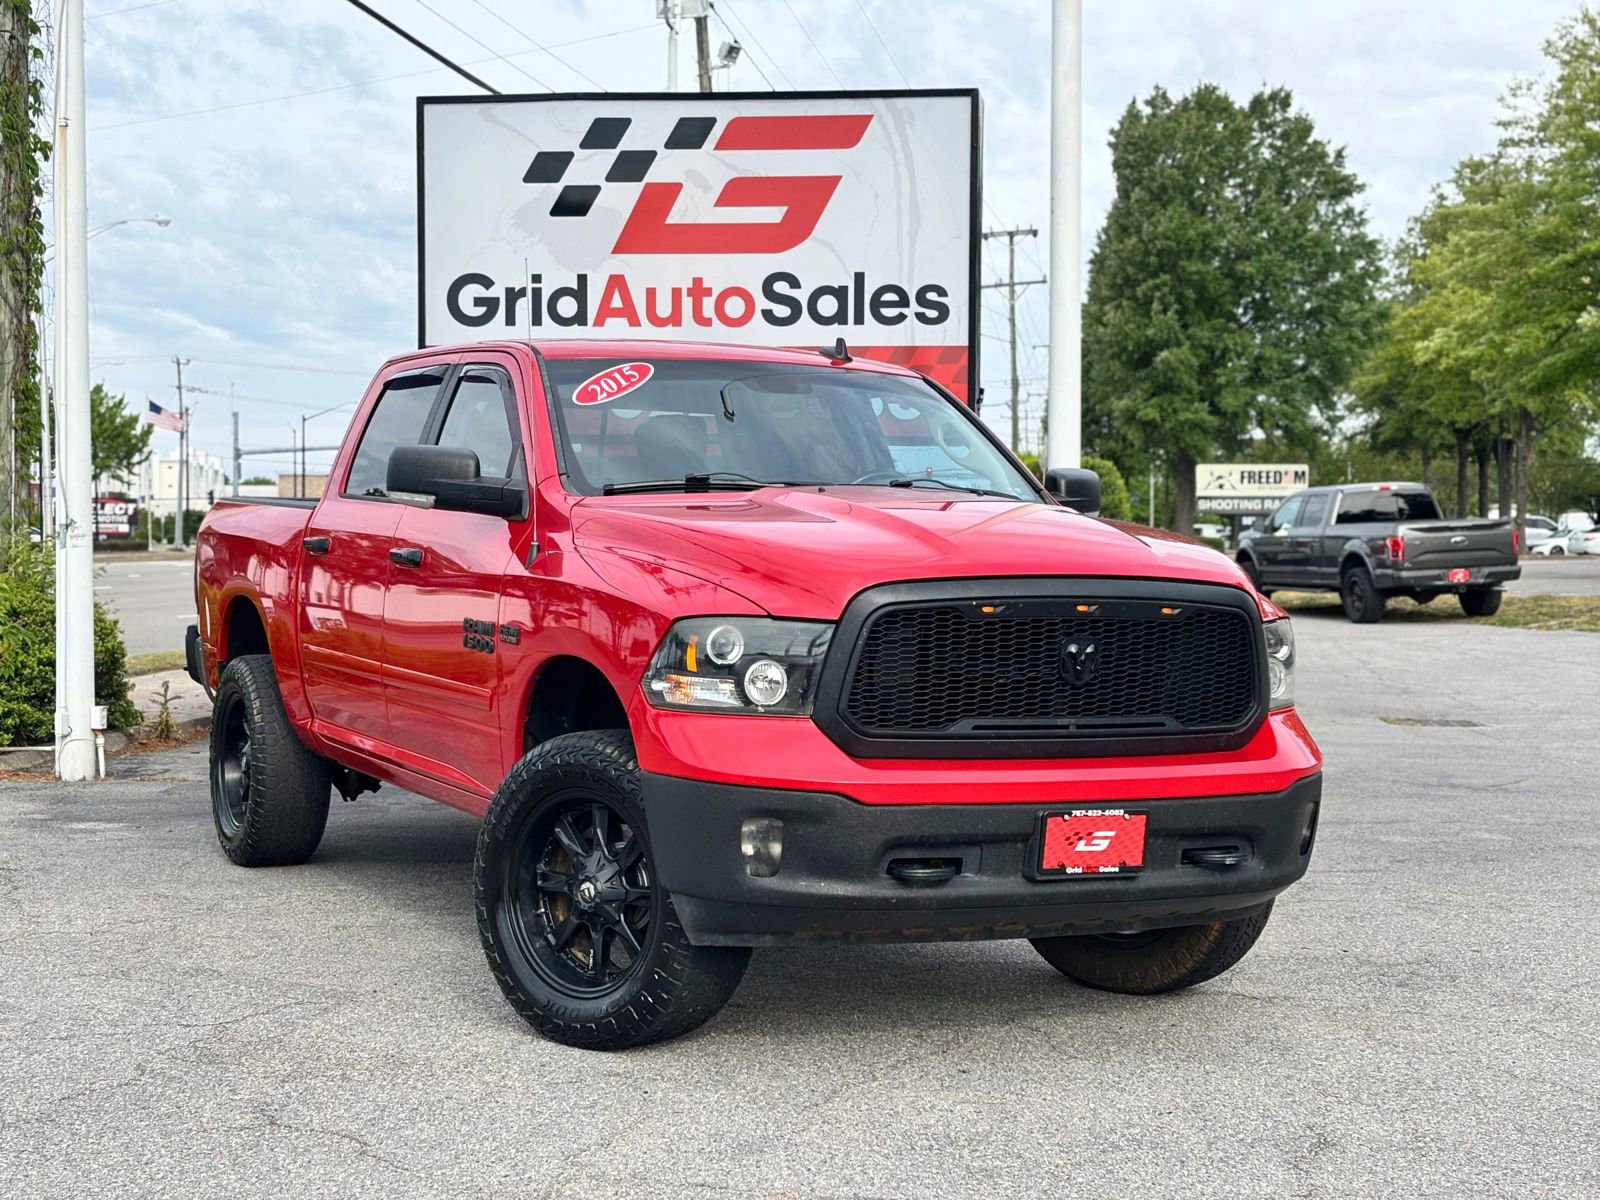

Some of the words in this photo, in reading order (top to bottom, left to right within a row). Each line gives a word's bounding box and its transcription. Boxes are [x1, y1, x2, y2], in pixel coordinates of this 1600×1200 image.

[588, 366, 640, 401] 2015
[1198, 499, 1262, 510] SHOOTING
[1264, 499, 1282, 510] RA
